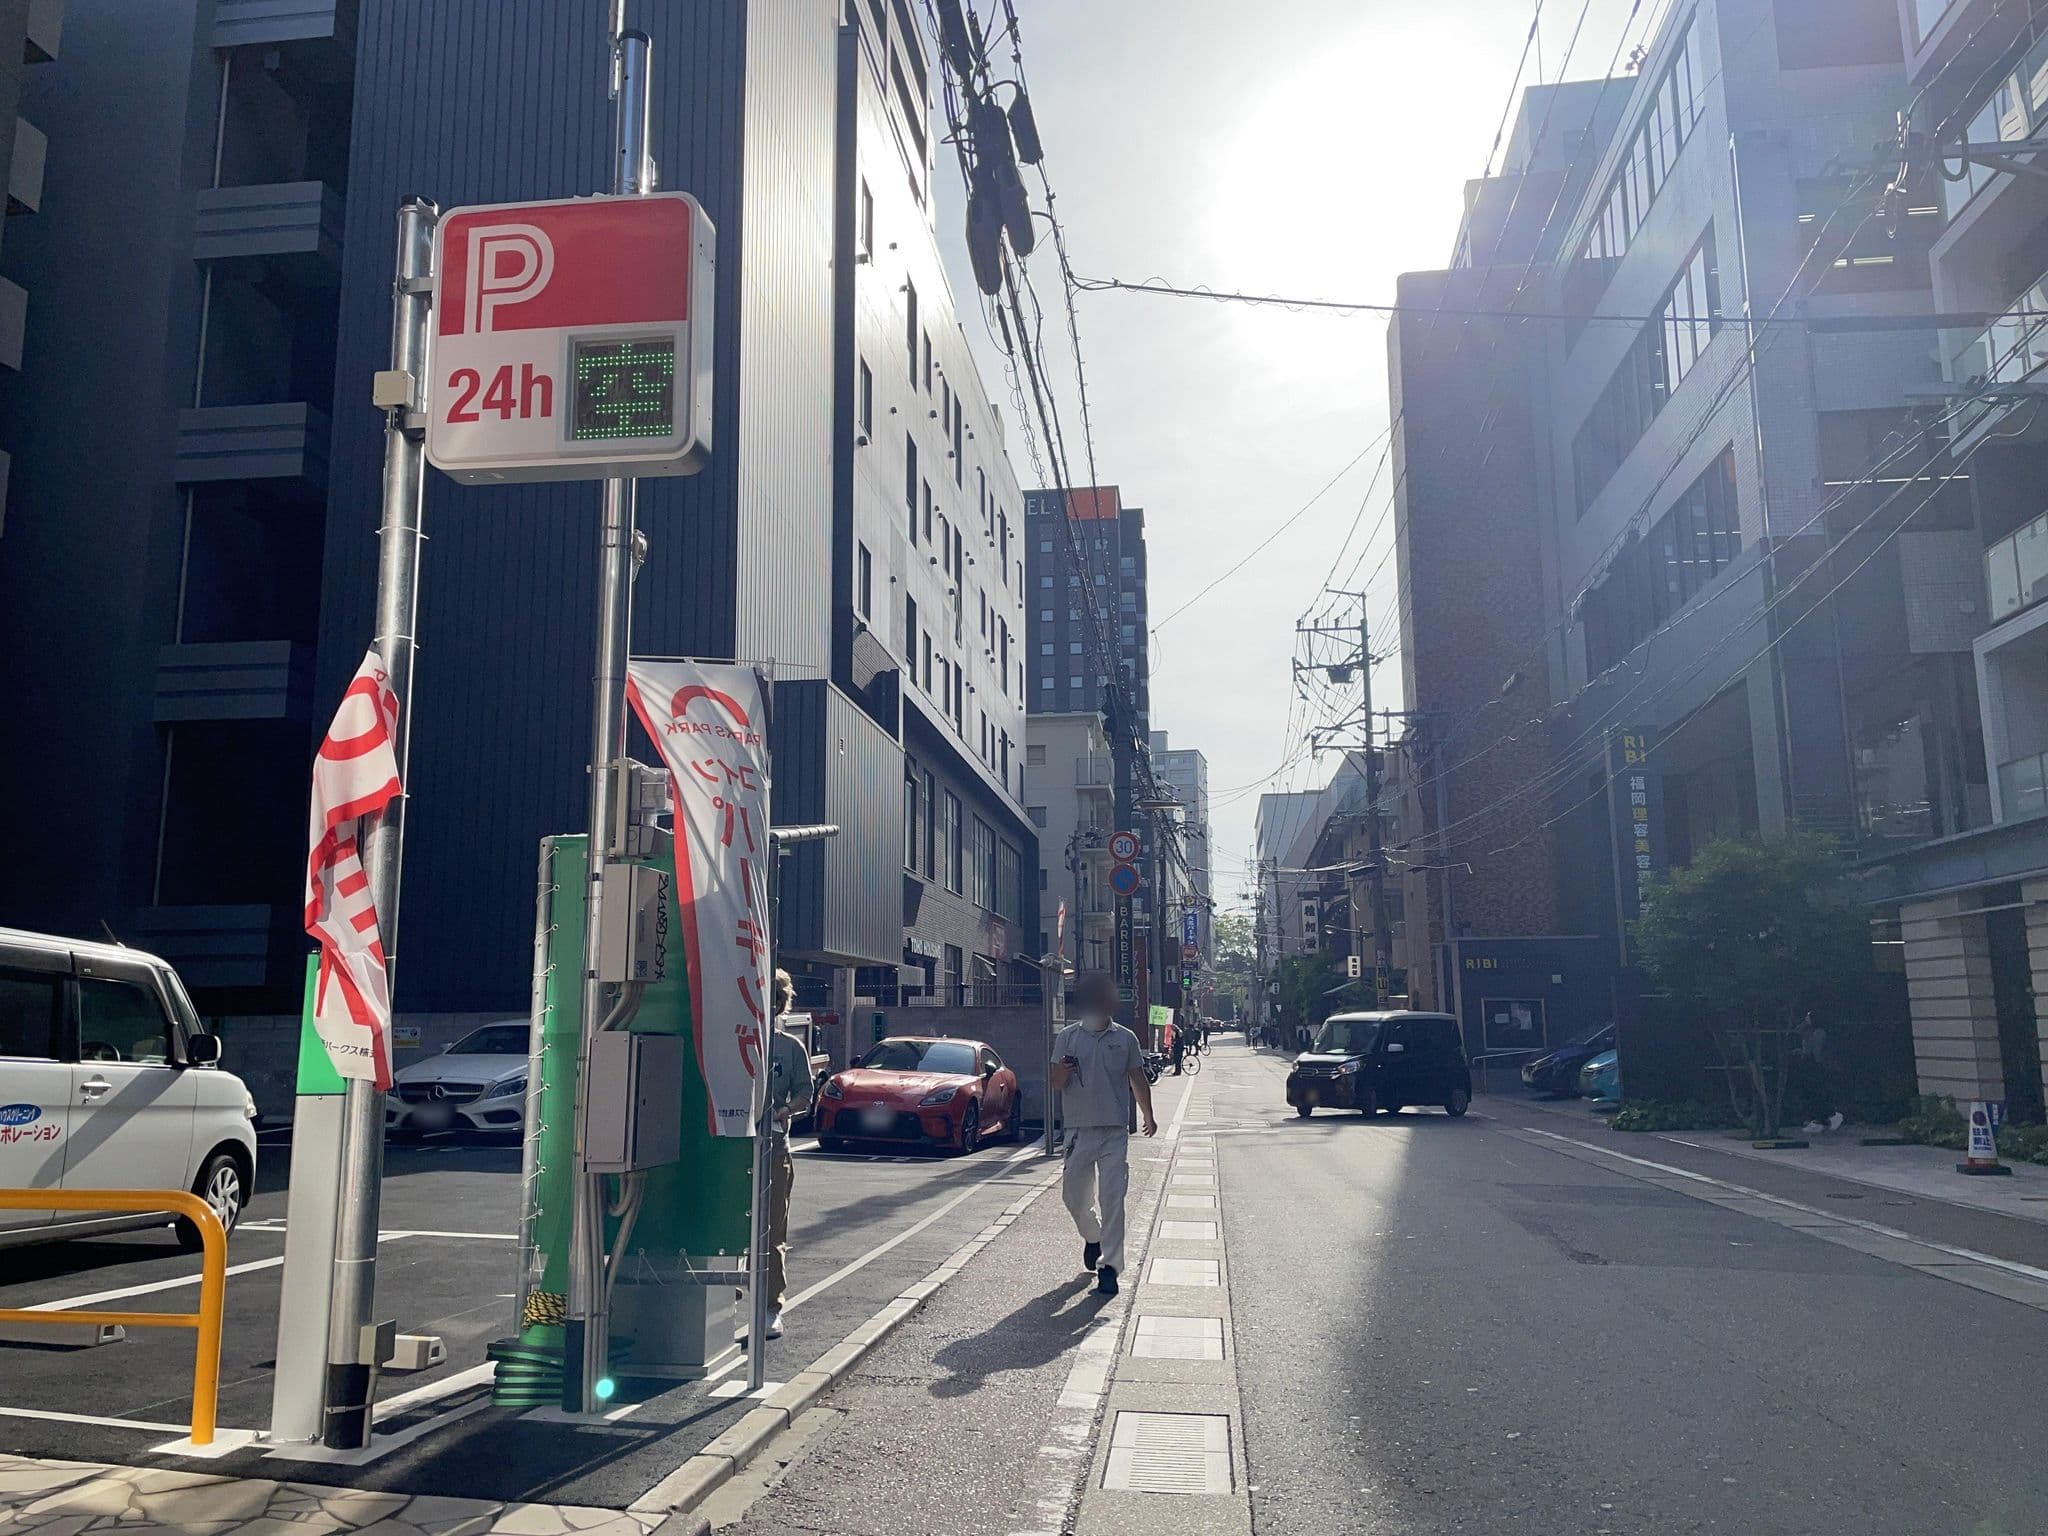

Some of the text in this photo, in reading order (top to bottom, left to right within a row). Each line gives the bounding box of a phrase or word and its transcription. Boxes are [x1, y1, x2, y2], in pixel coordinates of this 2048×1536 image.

[464, 223, 555, 333] P
[446, 363, 554, 424] 24h
[576, 342, 674, 440] 空
[1115, 840, 1133, 854] 30
[1119, 906, 1129, 975] BARBER
[1466, 958, 1498, 969] RIBI
